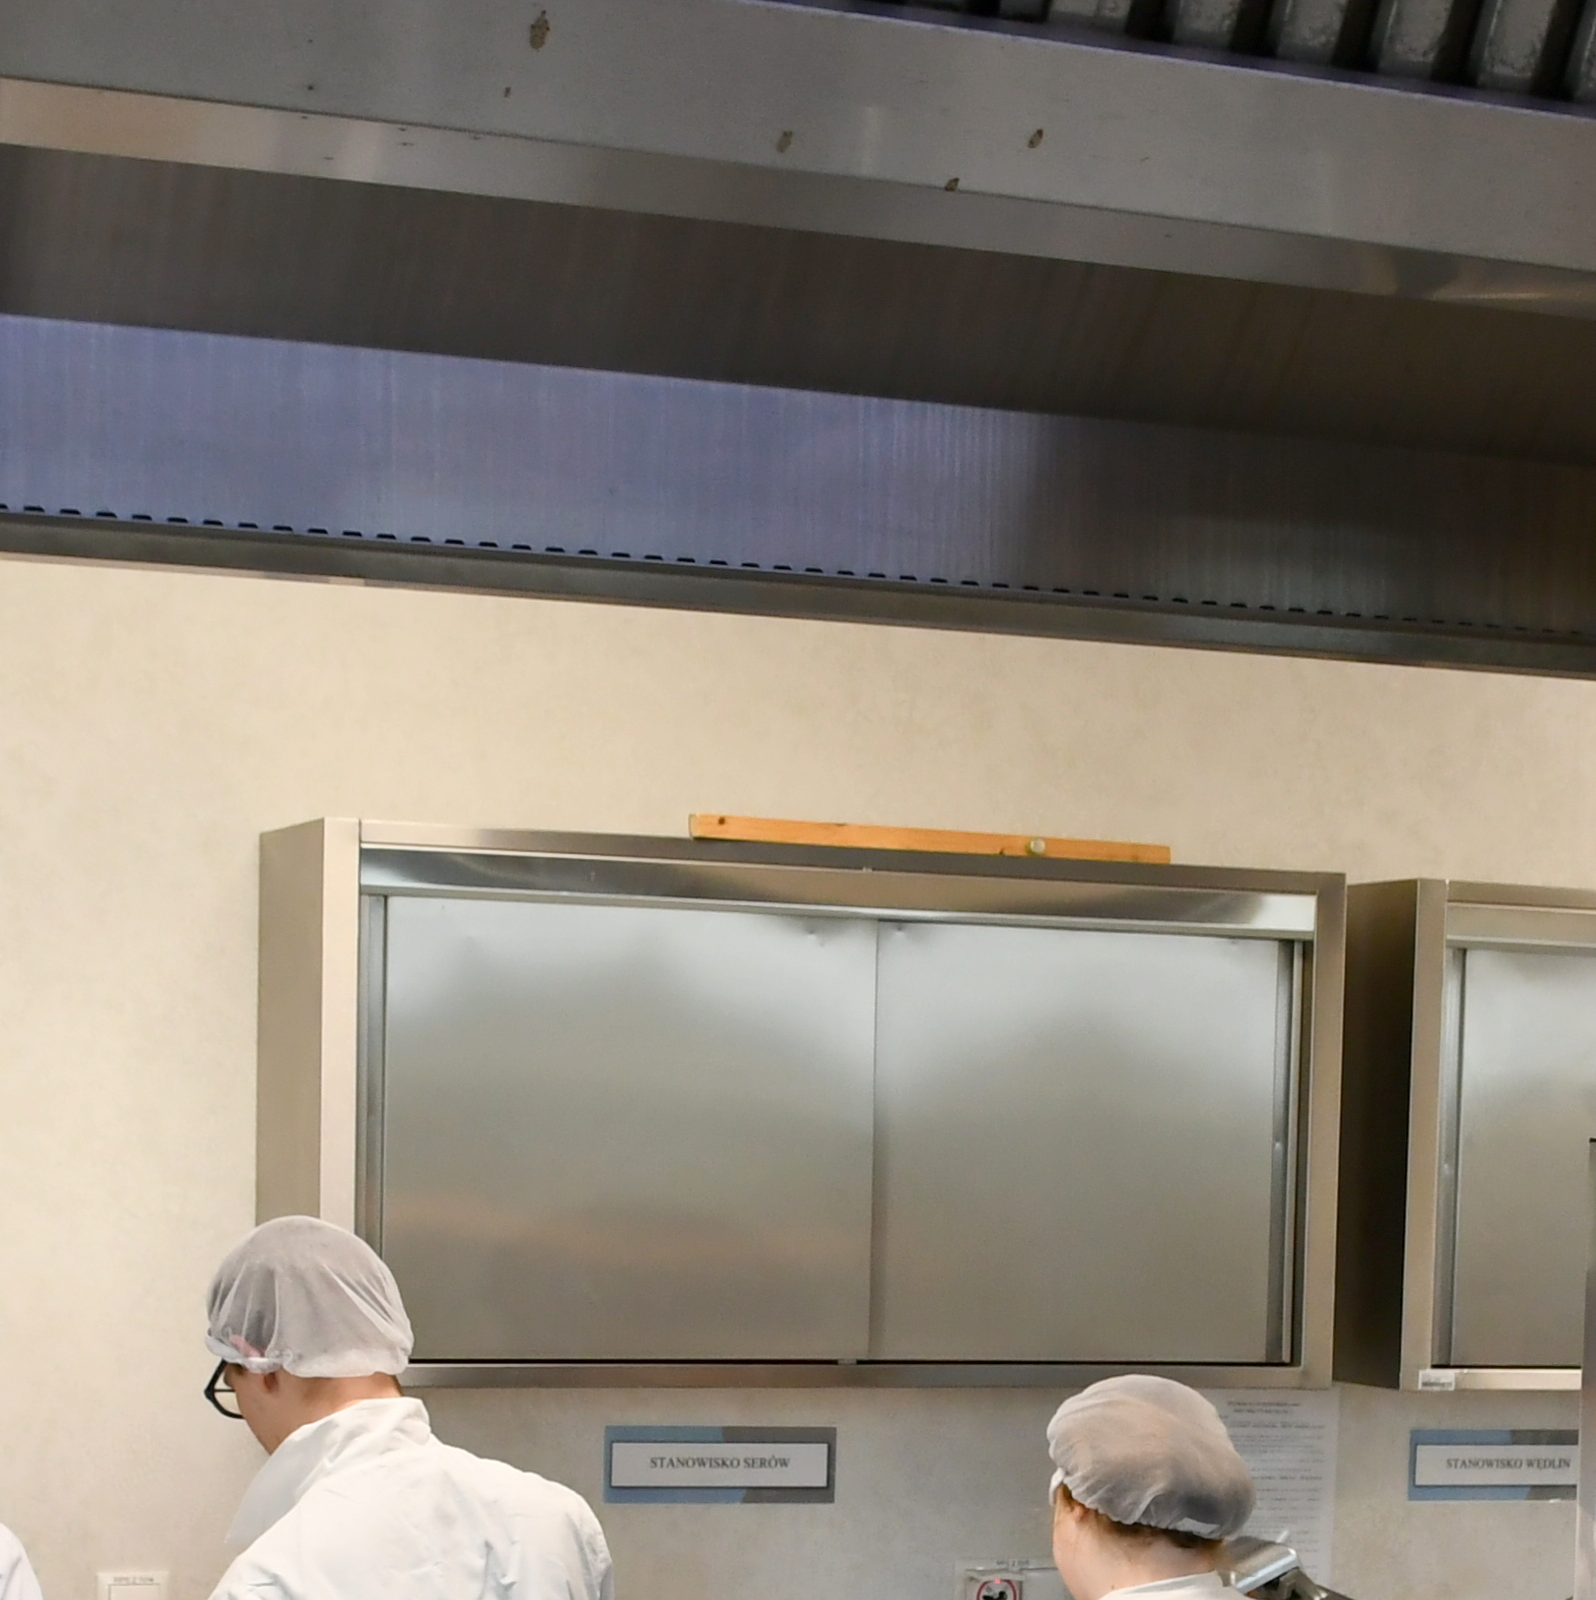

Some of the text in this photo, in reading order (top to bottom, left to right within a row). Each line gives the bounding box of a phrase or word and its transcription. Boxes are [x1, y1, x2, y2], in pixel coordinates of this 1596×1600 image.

[650, 1454, 791, 1469] STANOWISKO SERÓW
[1446, 1457, 1571, 1470] STANOWISKO WĘDLIN
